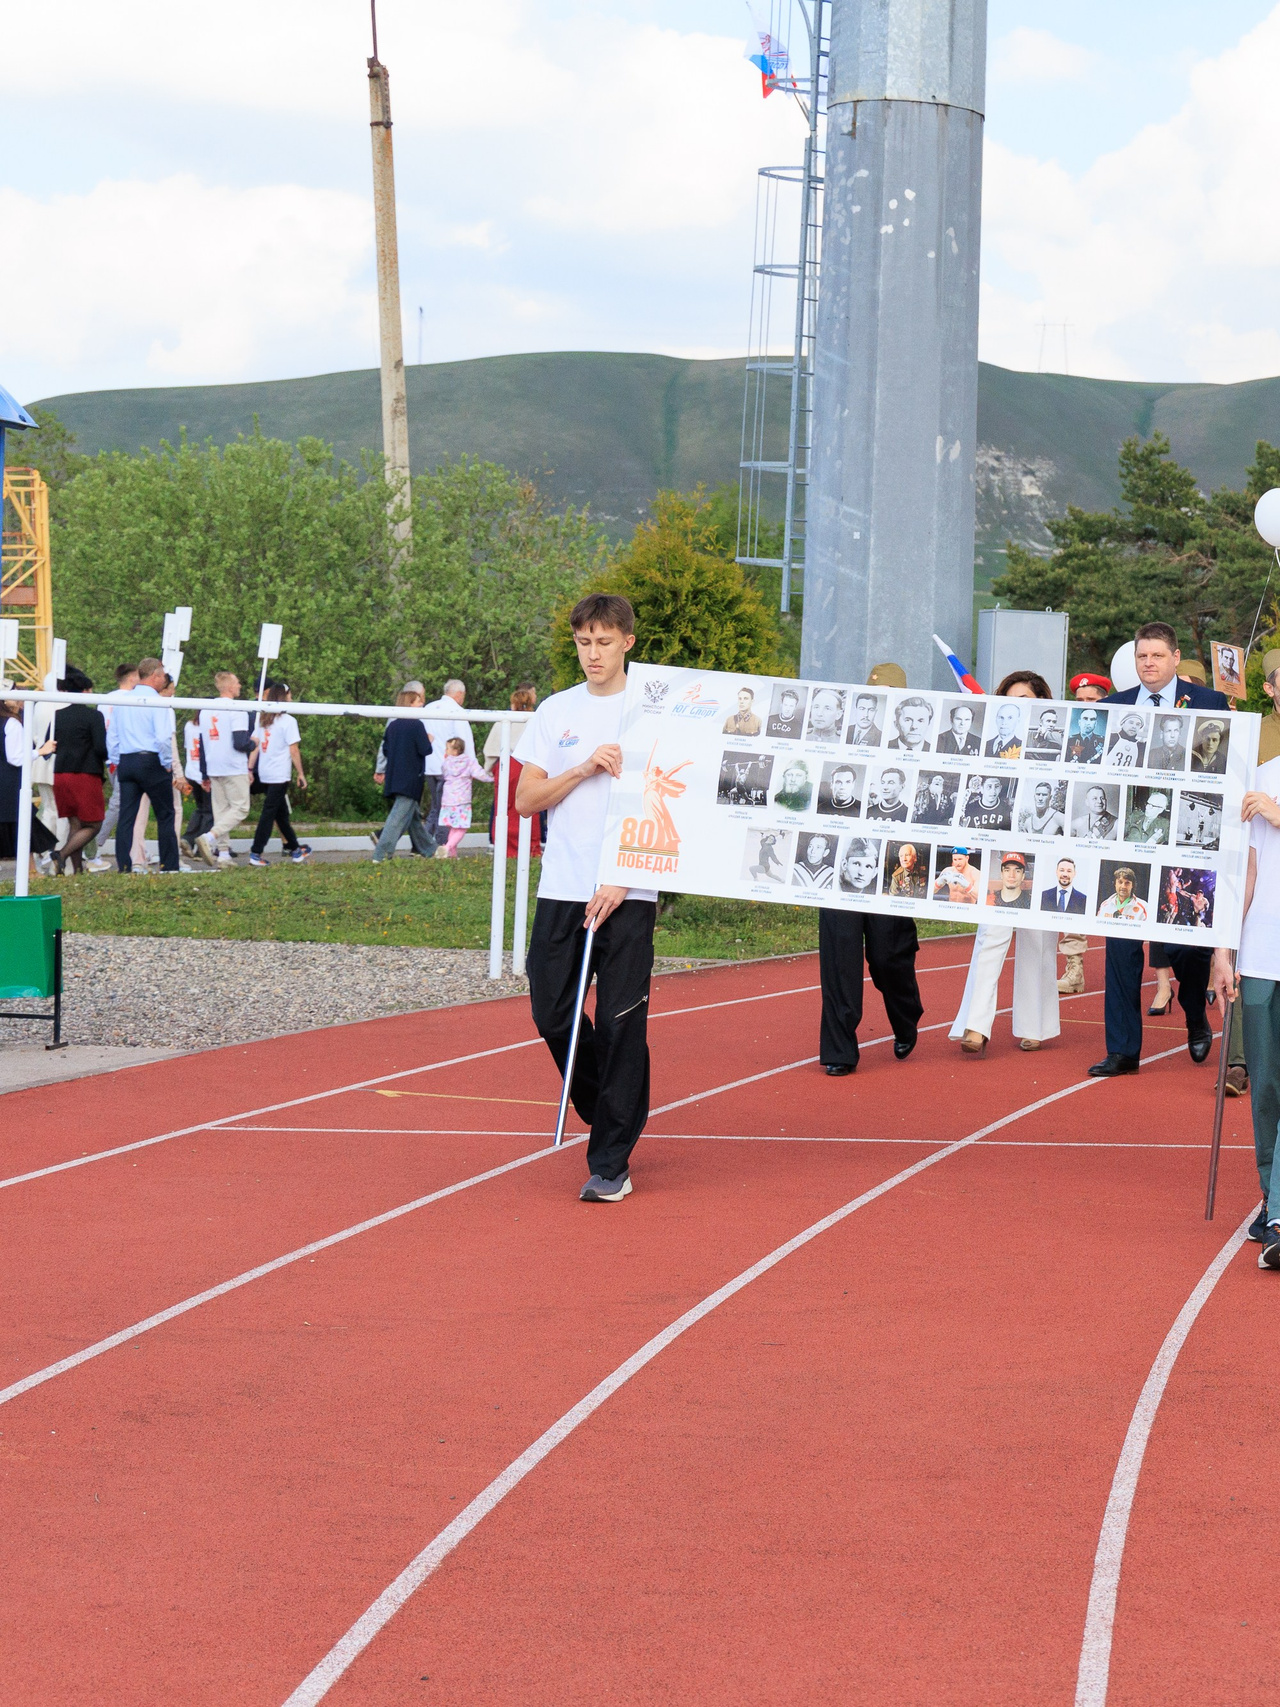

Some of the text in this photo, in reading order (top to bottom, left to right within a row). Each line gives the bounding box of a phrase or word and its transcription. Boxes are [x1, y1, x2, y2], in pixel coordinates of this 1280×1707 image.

[672, 704, 690, 714] ЮГ
[772, 722, 792, 733] СССР
[973, 814, 1004, 826] СССР
[620, 817, 656, 848] 80
[616, 852, 679, 874] ПОБЕДА!
